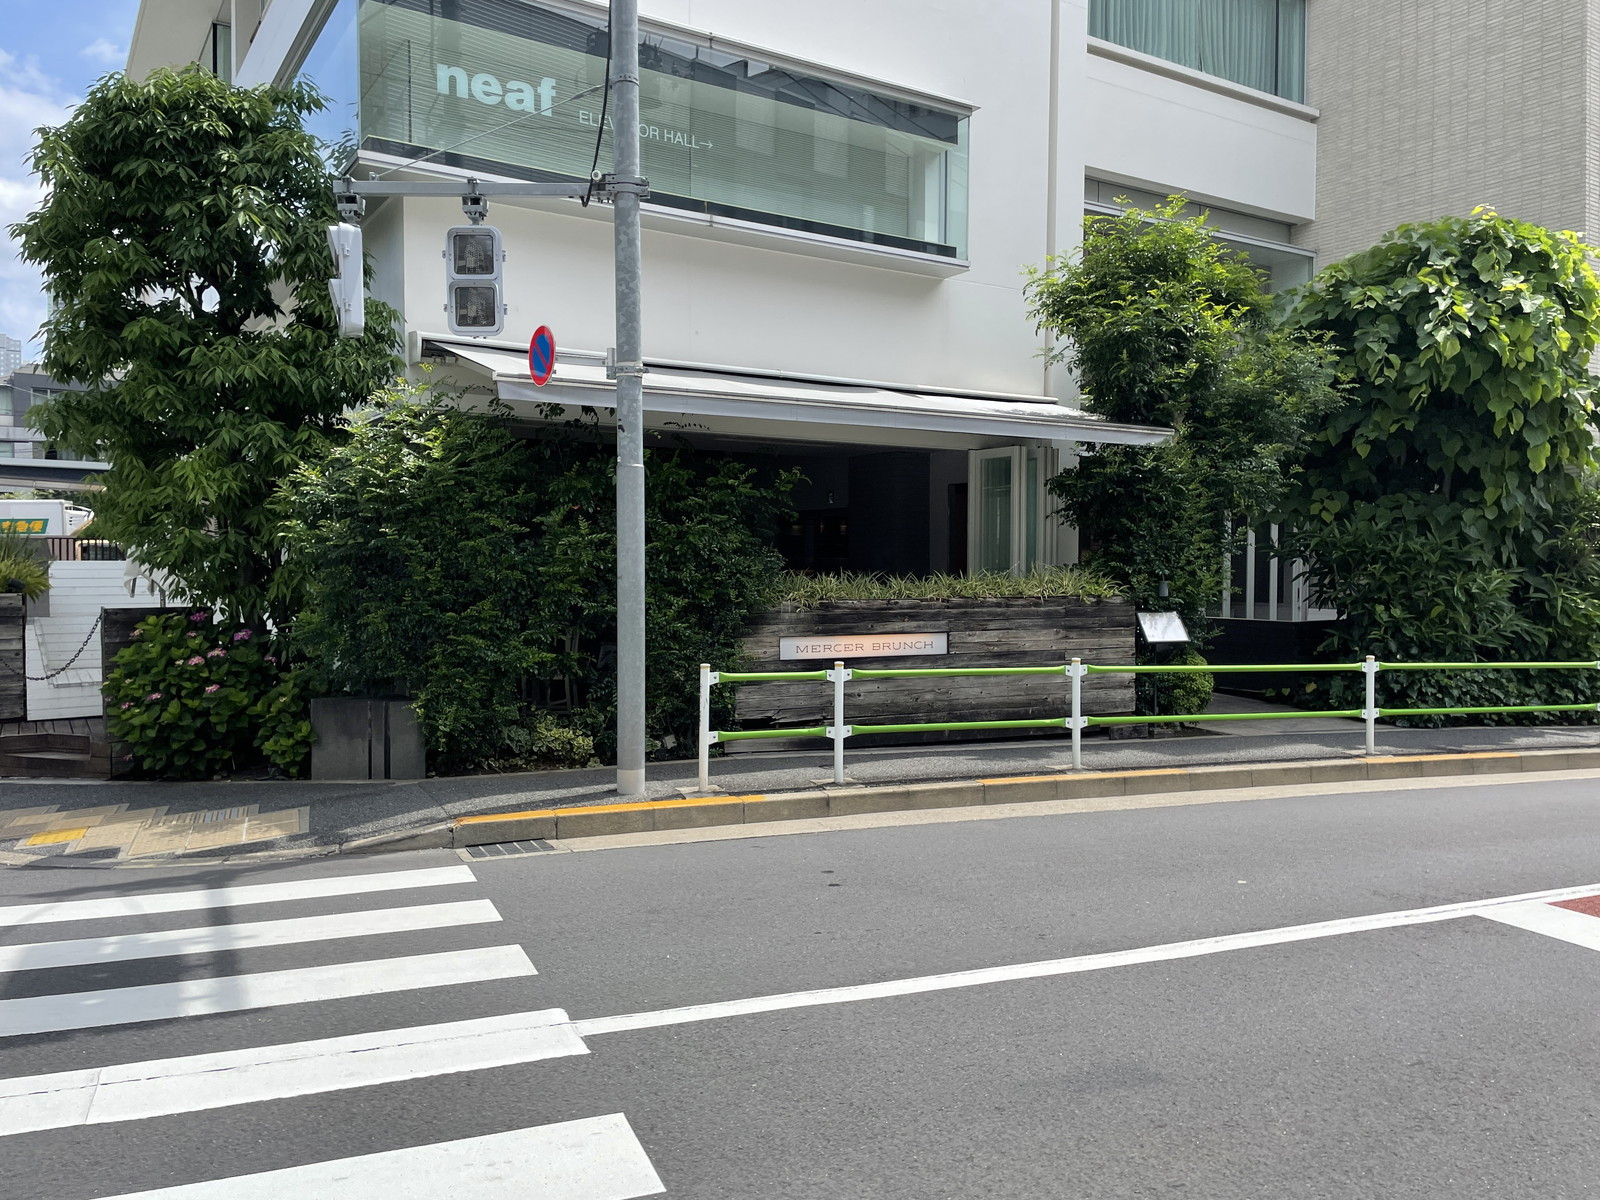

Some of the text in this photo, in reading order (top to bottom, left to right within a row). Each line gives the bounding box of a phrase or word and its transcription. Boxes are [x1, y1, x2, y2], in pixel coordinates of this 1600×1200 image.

[436, 63, 556, 117] neaf
[664, 129, 700, 149] HALL
[796, 640, 934, 654] MERCER BRUNCH
